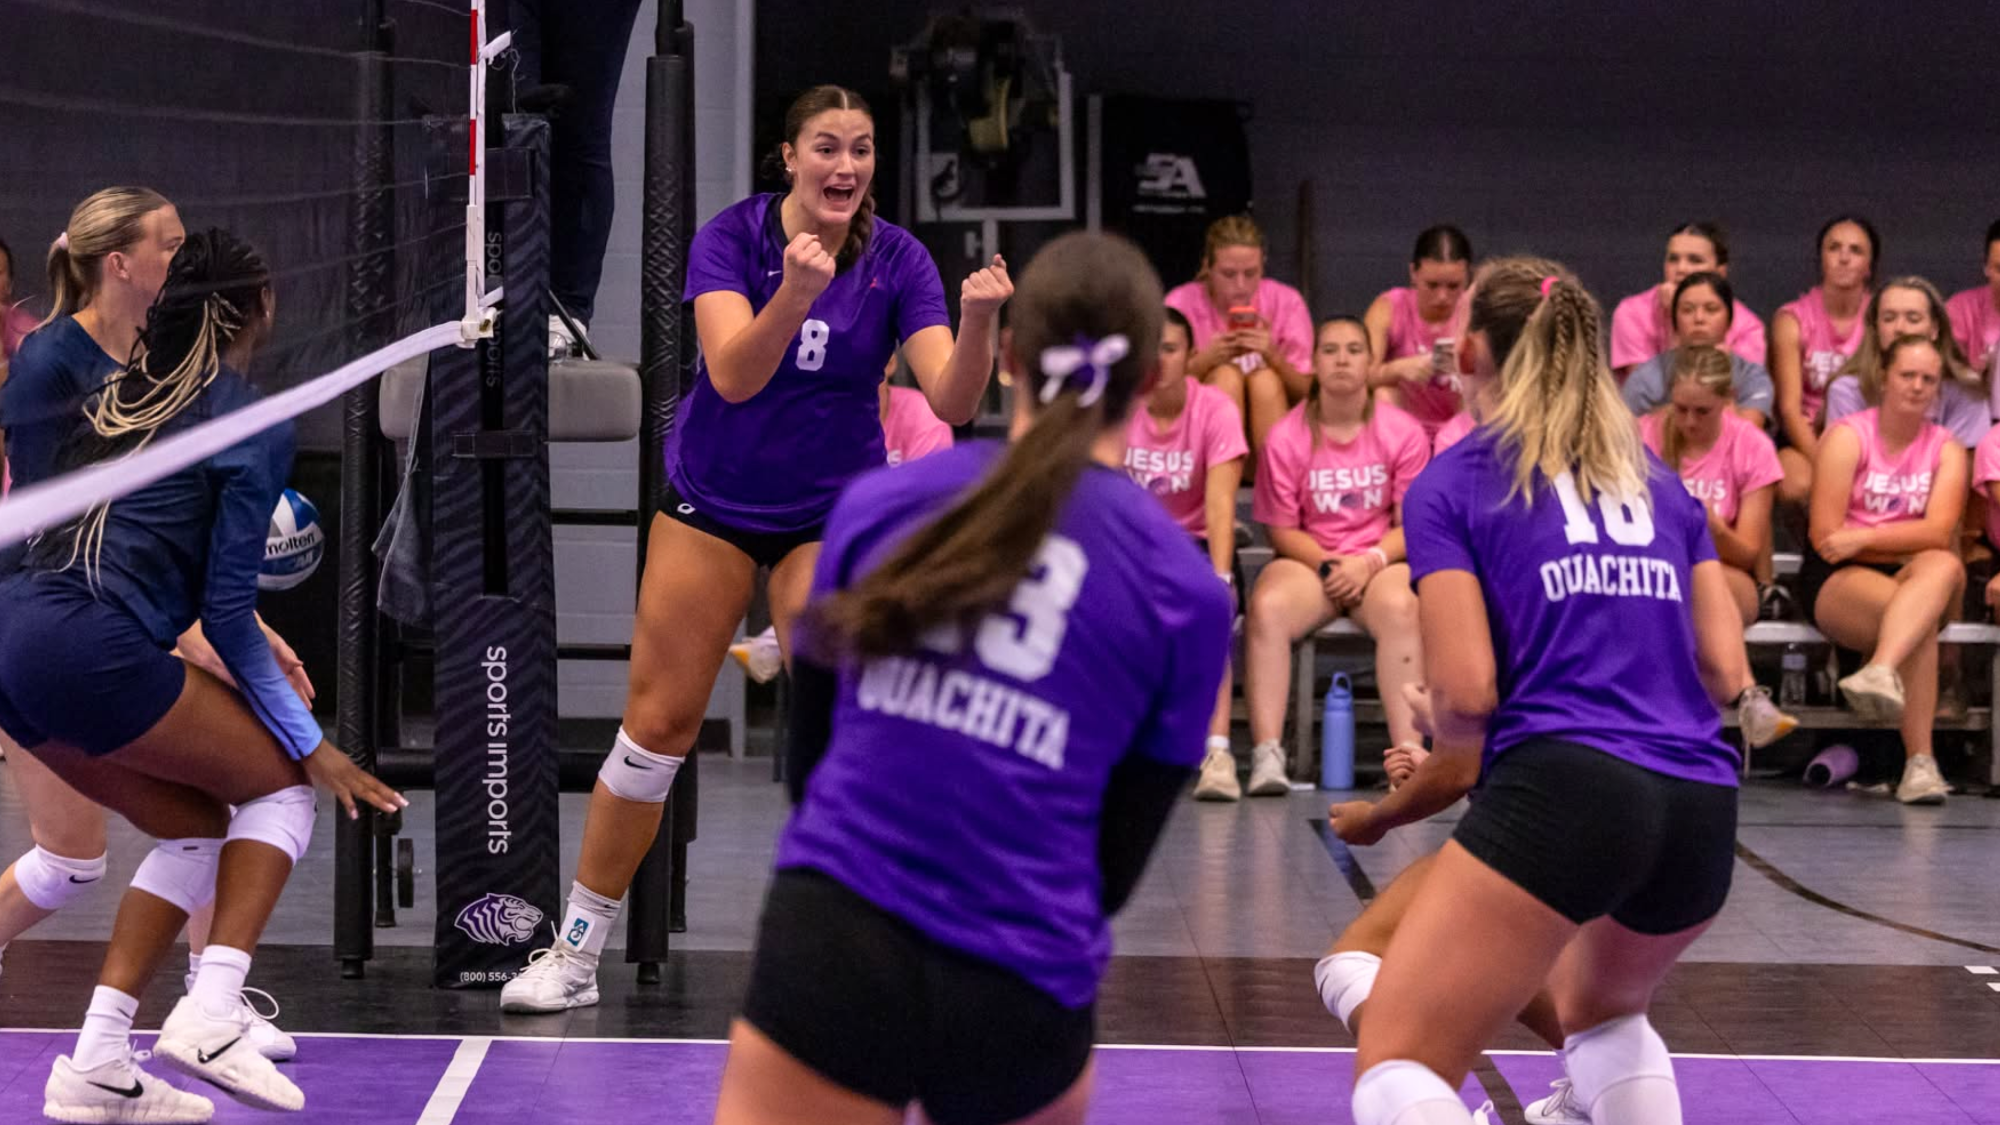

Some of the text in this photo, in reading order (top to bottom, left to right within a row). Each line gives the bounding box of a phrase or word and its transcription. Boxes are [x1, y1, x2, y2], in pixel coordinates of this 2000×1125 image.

[795, 318, 830, 372] 8
[1123, 447, 1195, 473] JESUS
[1309, 464, 1388, 491] JESUS
[1864, 471, 1931, 495] JESUS
[1540, 553, 1684, 603] OUACHITA
[481, 646, 512, 854] sports imports
[459, 971, 486, 983] (800)
